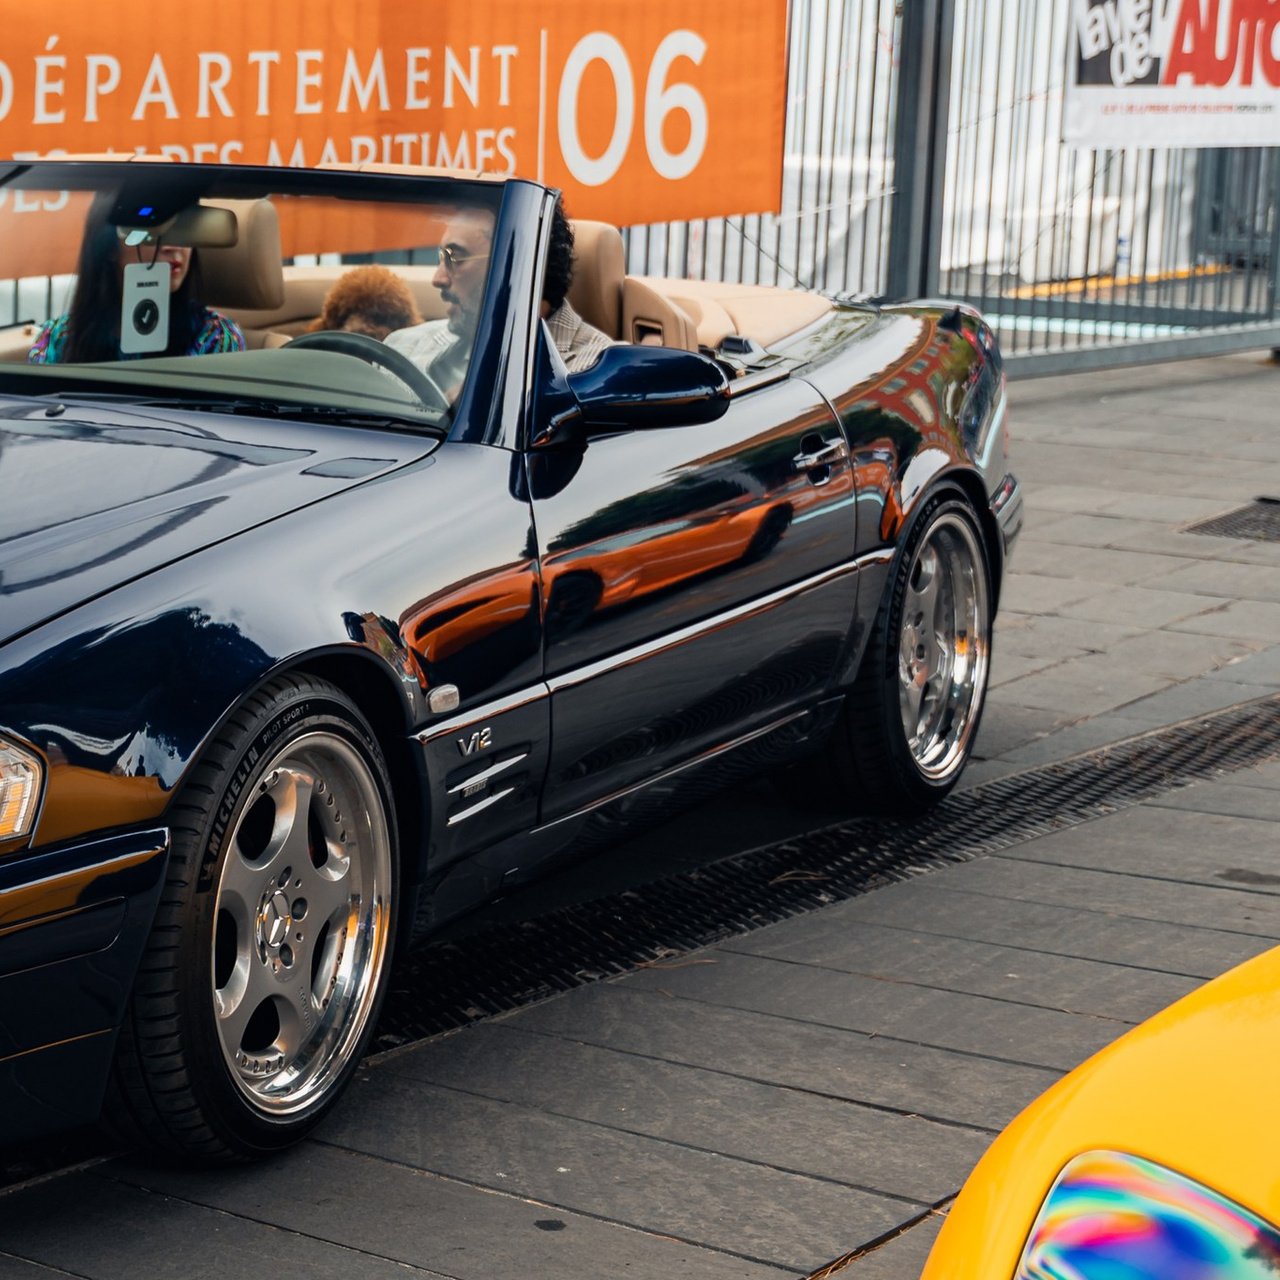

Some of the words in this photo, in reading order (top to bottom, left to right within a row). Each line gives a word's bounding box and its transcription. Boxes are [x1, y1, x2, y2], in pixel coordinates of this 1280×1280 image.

[1110, 31, 1152, 87] de
[558, 30, 708, 186] 06
[283, 705, 304, 724] SPORT
[456, 727, 492, 757] V12
[208, 746, 259, 857] MICHELIN
